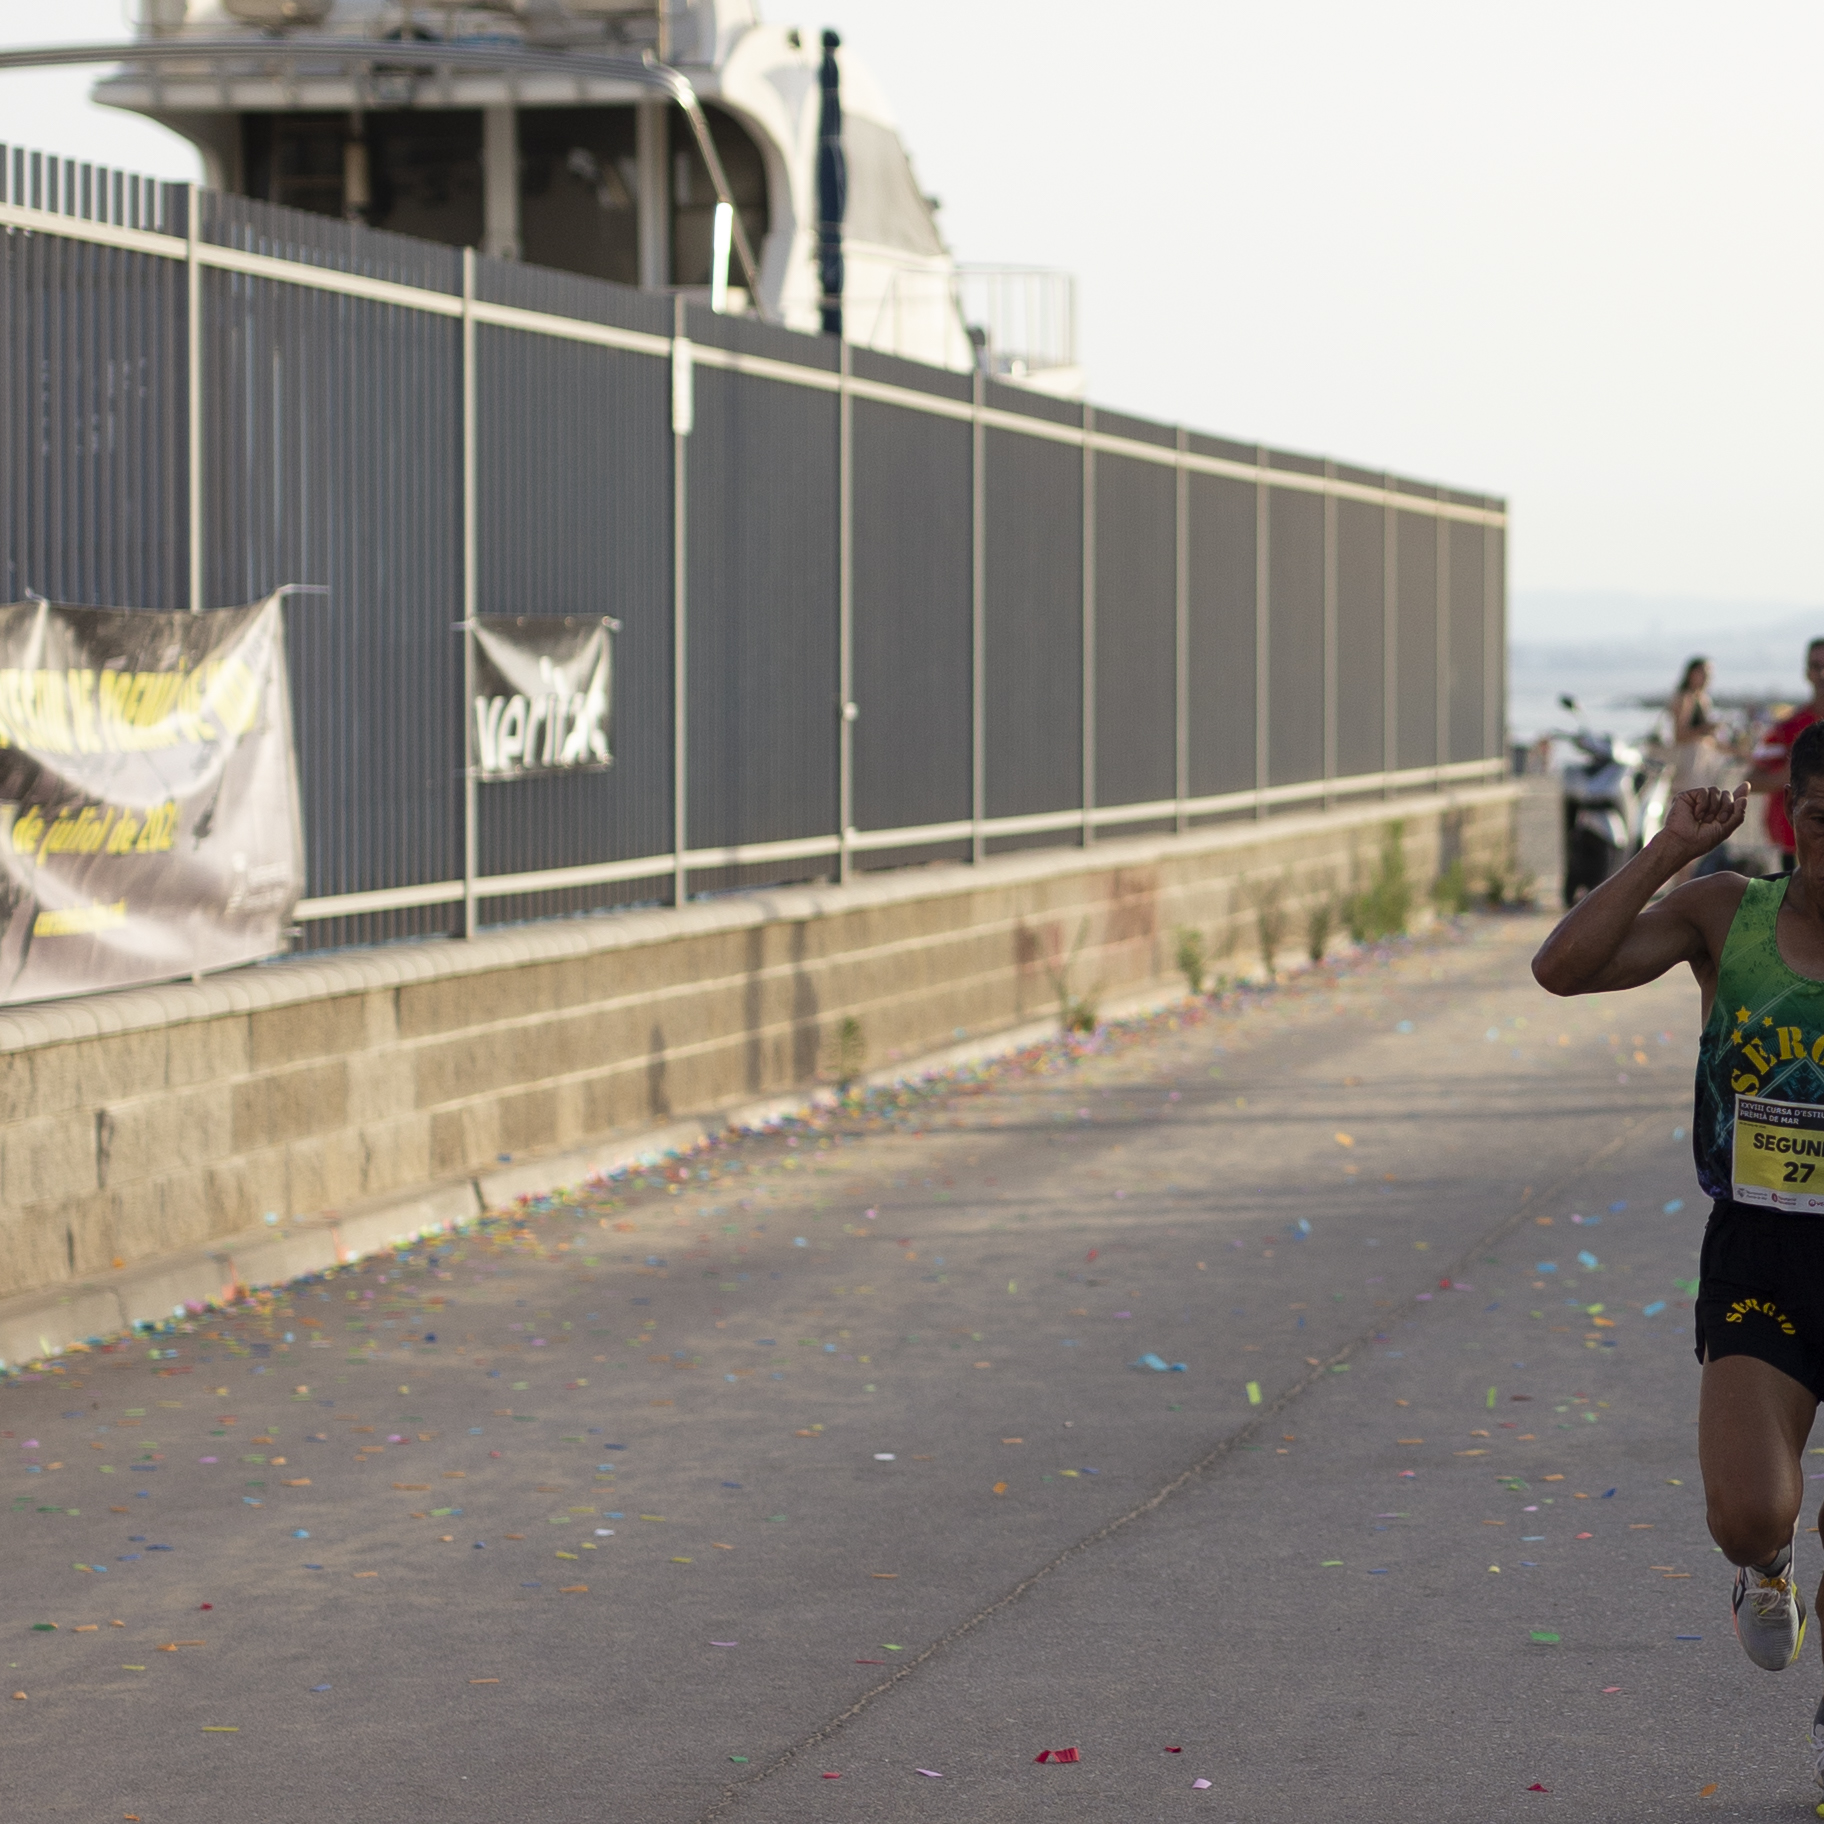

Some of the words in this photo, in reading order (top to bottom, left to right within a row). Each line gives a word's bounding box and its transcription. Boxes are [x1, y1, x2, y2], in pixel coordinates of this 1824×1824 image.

[1740, 1101, 1764, 1112] XXVIII
[1766, 1106, 1792, 1116] CURSA
[1769, 1115, 1778, 1123] DE
[1780, 1116, 1799, 1125] MAR
[1783, 1162, 1815, 1183] 27
[1726, 1298, 1796, 1335] SERGIO
